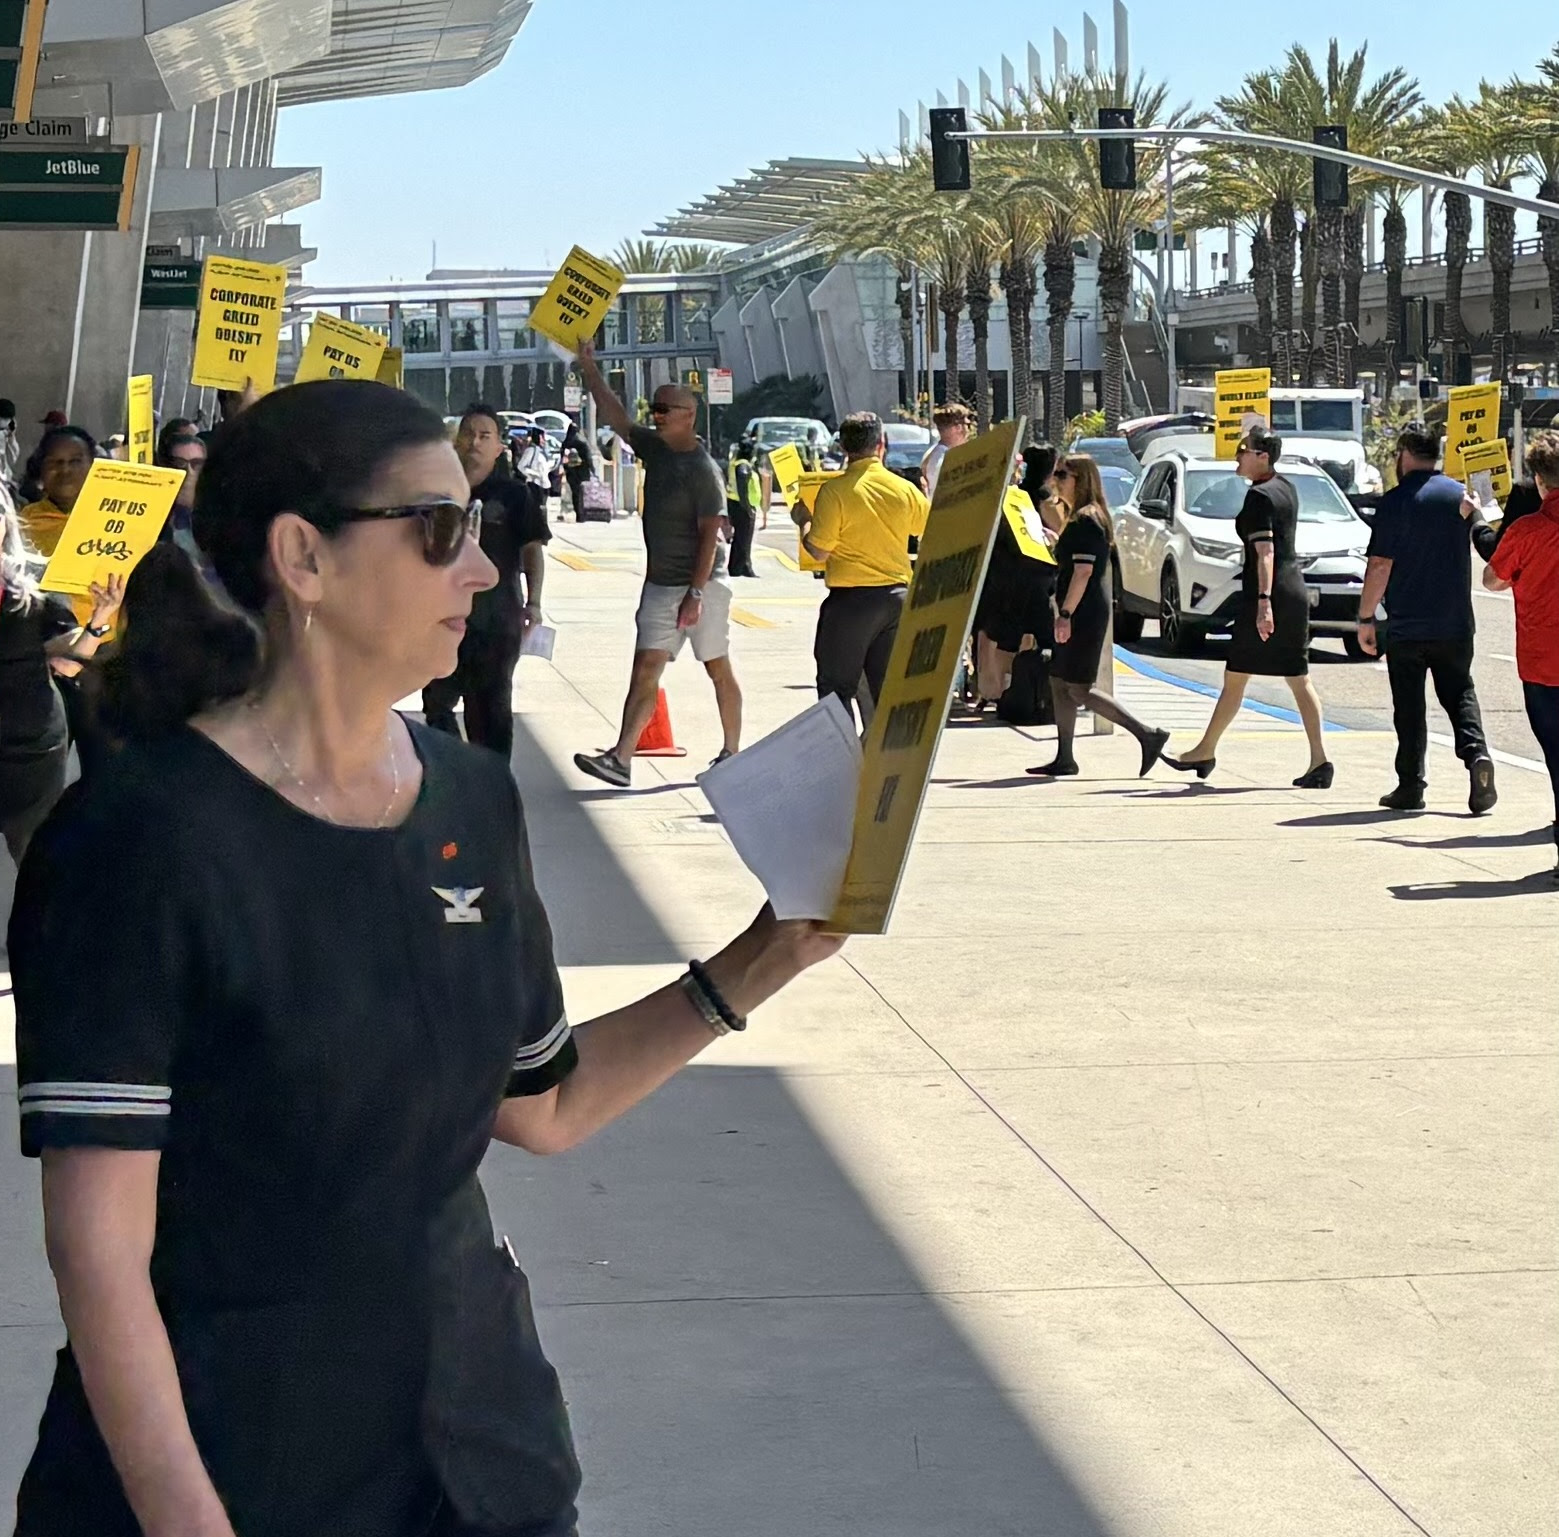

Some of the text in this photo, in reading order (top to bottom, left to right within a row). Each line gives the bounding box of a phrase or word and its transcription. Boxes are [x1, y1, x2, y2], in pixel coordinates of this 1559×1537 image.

[25, 121, 72, 137] Claim
[45, 160, 100, 175] JetBlue
[209, 287, 277, 310] CORPORATE
[223, 309, 260, 326] GREED
[229, 348, 247, 363] FLY
[323, 345, 361, 369] PAY US
[98, 498, 147, 516] PAY US
